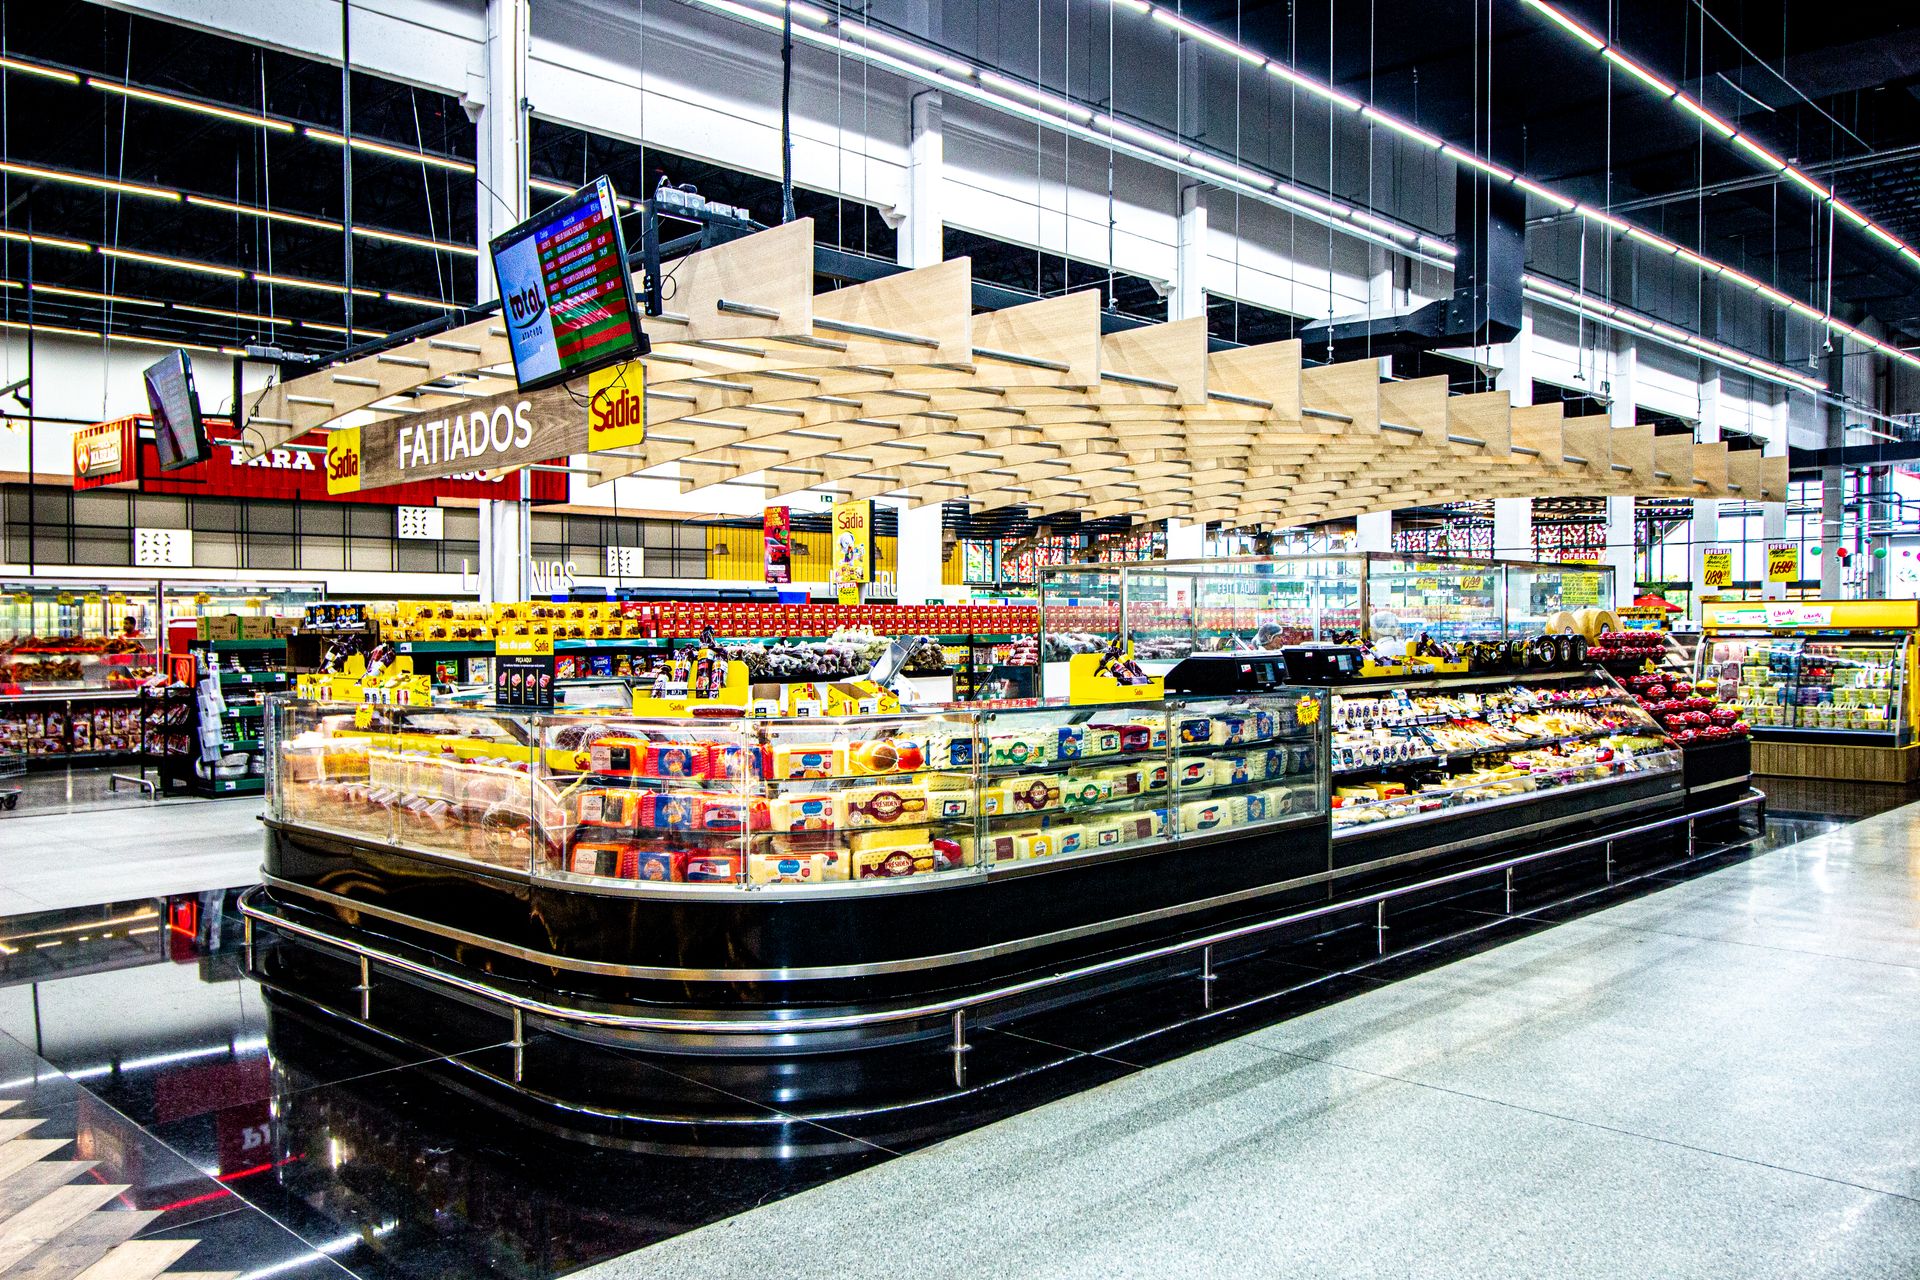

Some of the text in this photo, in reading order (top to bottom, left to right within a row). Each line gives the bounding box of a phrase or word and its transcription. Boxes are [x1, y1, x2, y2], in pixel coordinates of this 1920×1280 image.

[591, 388, 640, 432] Sadia
[400, 401, 532, 470] FATIADOS
[328, 446, 358, 480] Sadia
[838, 511, 864, 529] Sadia
[535, 638, 549, 652] Sadia
